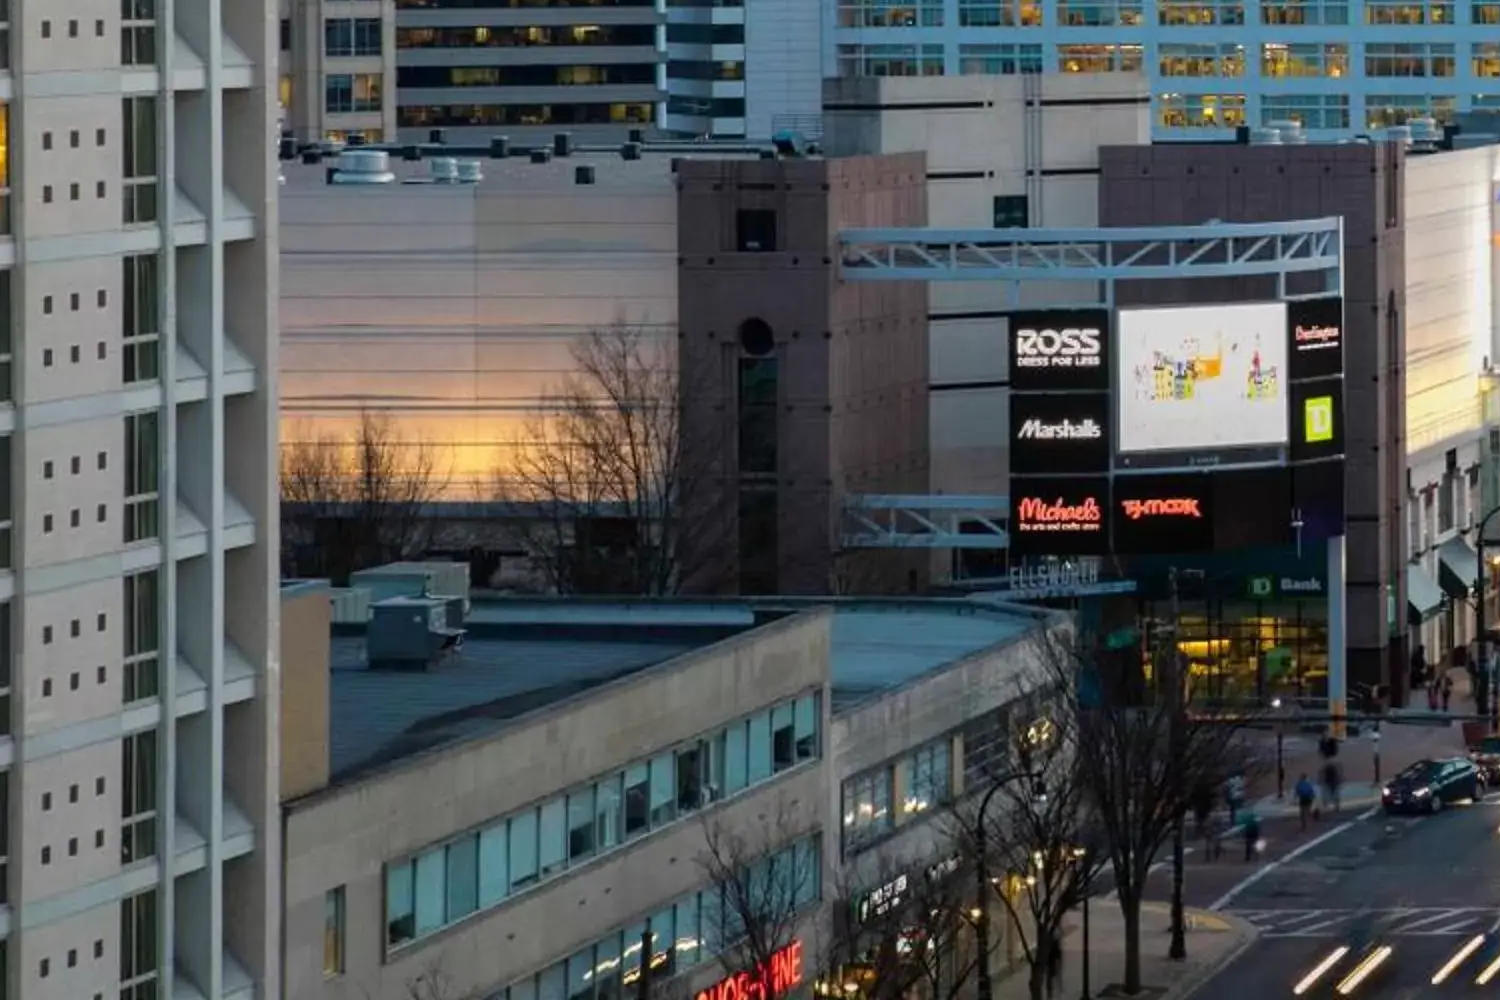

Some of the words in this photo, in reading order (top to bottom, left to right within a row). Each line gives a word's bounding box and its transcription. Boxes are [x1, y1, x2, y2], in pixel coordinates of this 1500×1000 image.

[1016, 328, 1101, 356] ROSS
[1017, 355, 1050, 368] DRESS
[1051, 355, 1074, 367] FOR
[1075, 354, 1101, 366] LESS
[1018, 419, 1101, 440] Marshalls
[1018, 496, 1101, 522] Michaels
[1009, 560, 1099, 589] ELLSWORTH
[1280, 576, 1322, 591] Bank
